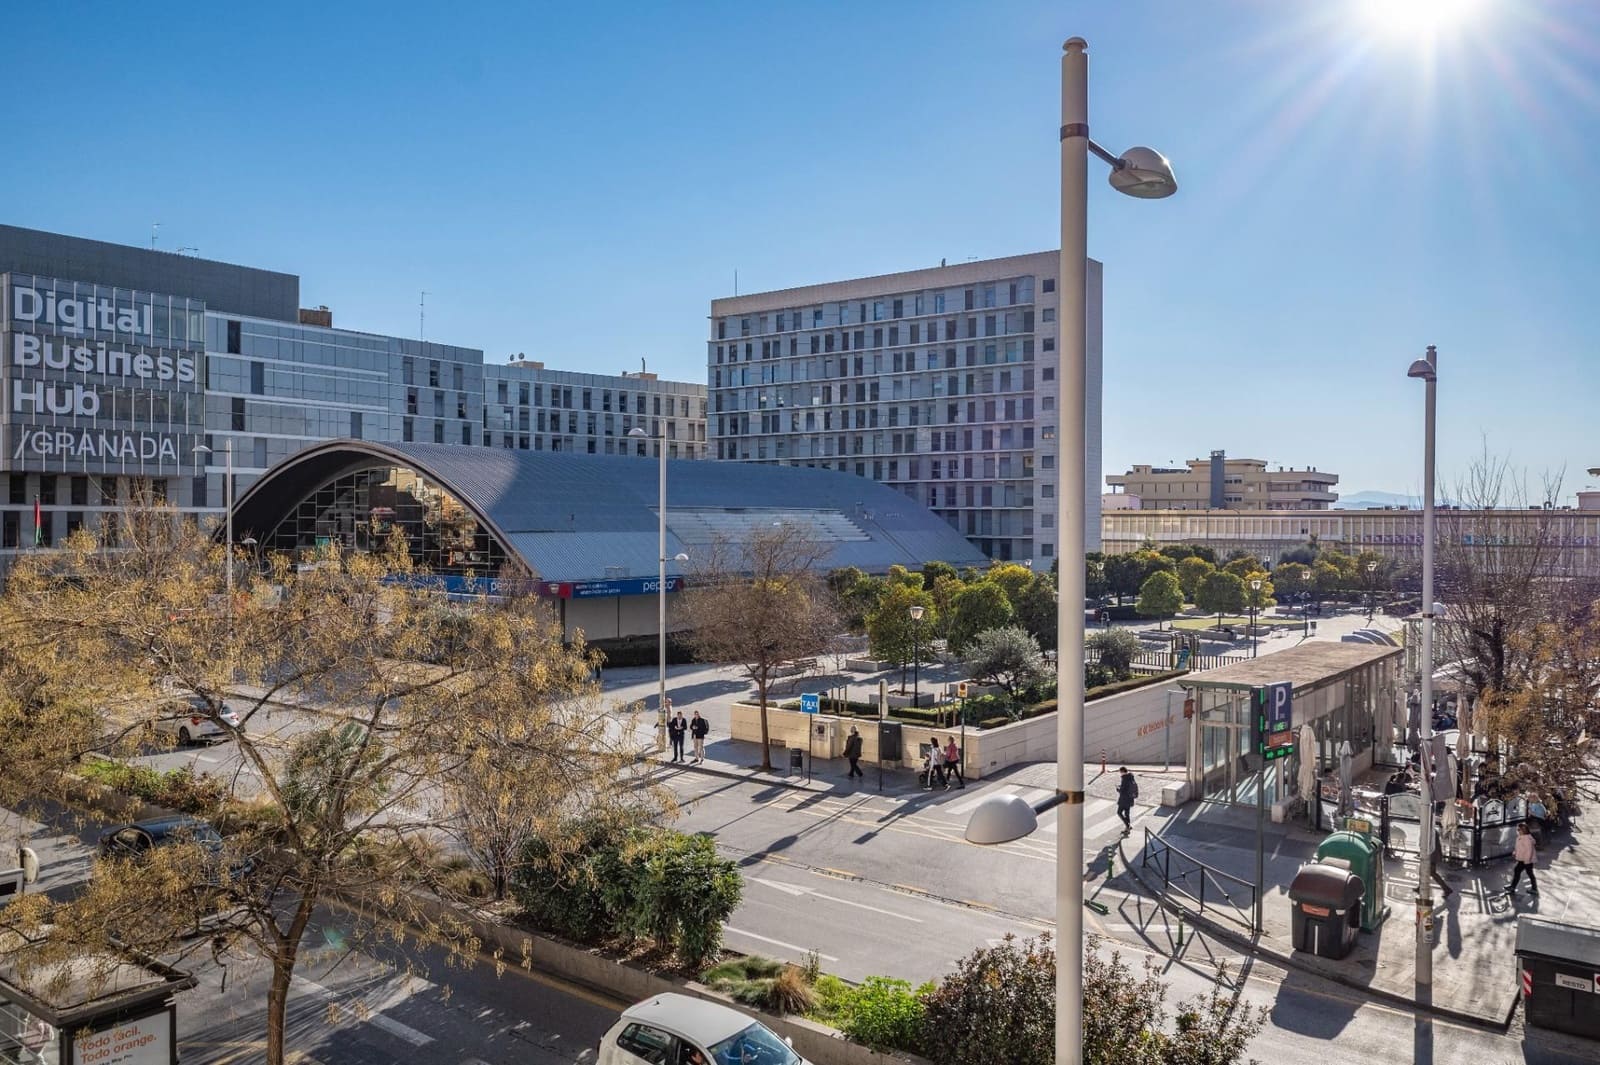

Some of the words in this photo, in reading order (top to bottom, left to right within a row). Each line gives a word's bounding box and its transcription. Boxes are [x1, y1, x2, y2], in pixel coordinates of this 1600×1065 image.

[14, 286, 151, 335] Digital
[14, 333, 195, 382] Business
[13, 379, 100, 416] Hub
[1275, 686, 1287, 721] P
[1562, 980, 1585, 989] RESTO
[81, 1036, 111, 1052] Todo
[81, 1047, 111, 1064] Todo
[113, 1033, 157, 1053] orange.
